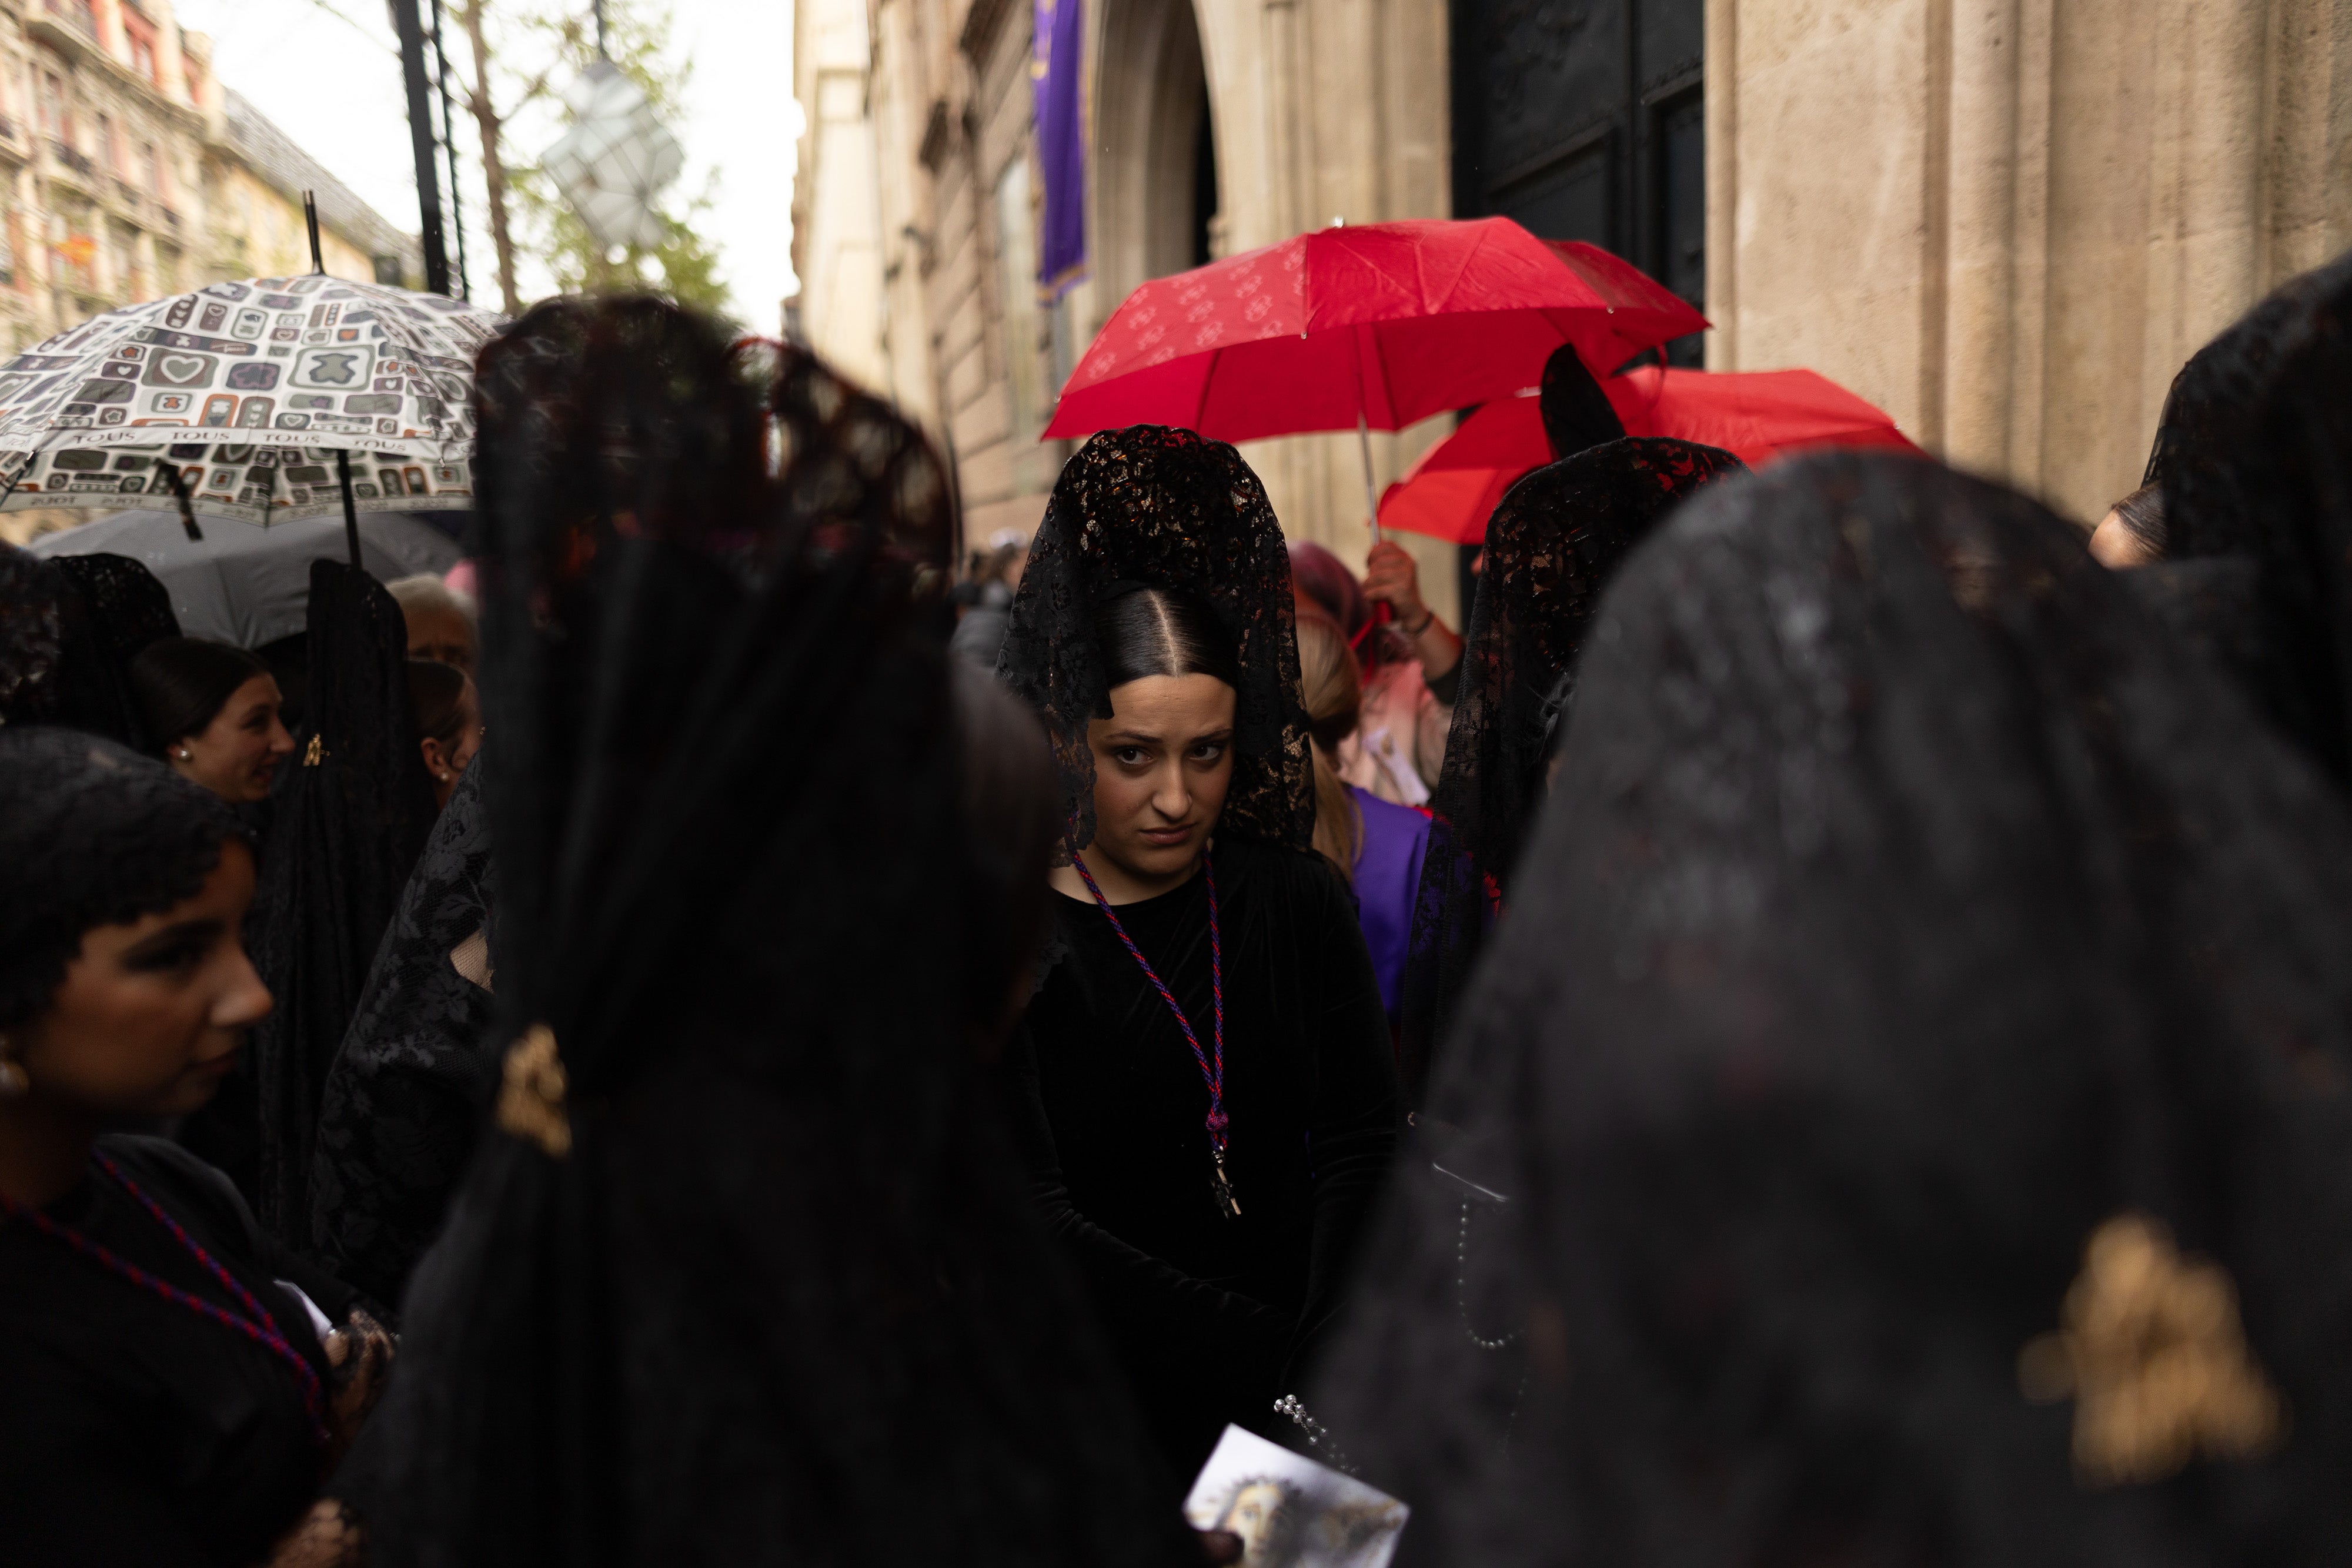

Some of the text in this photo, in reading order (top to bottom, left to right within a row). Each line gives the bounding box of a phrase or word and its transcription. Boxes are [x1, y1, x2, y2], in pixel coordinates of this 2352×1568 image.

[73, 432, 135, 444] TOUS
[172, 432, 230, 440] TOUS
[264, 433, 320, 443] TOUS
